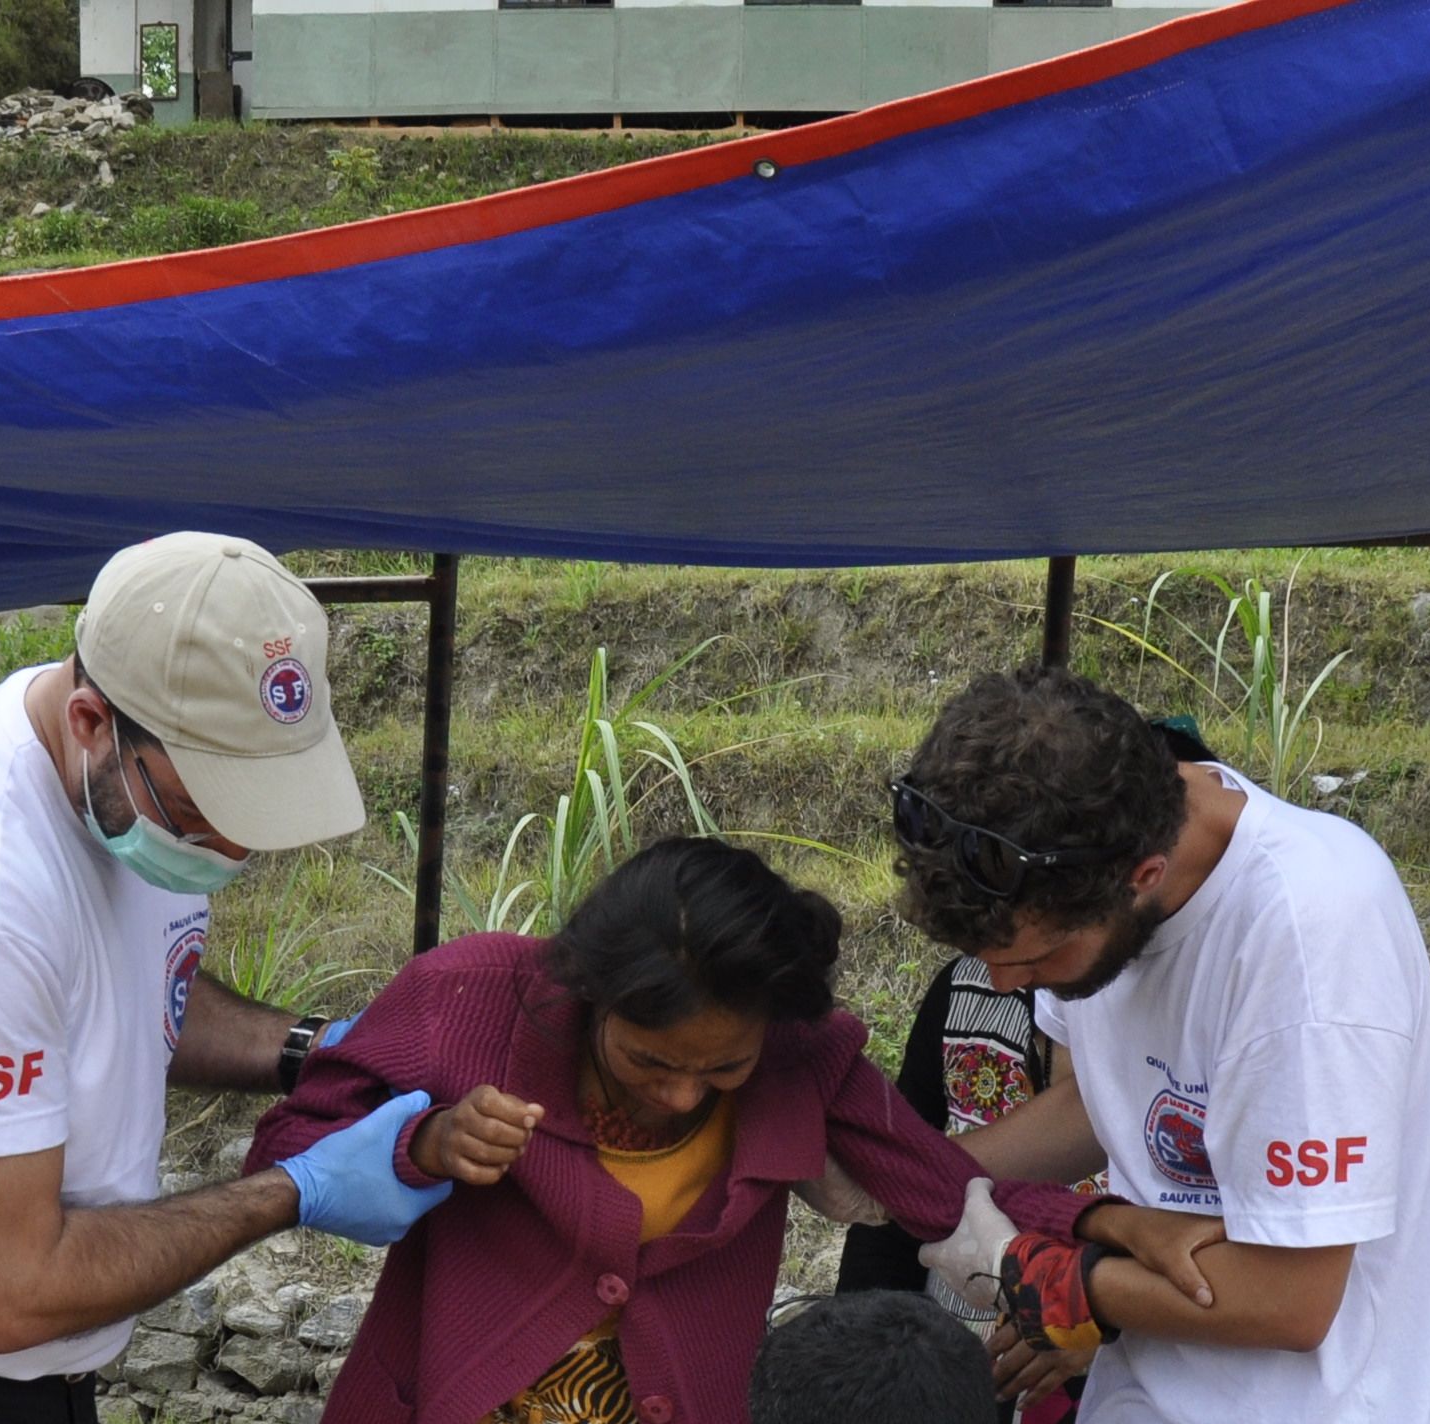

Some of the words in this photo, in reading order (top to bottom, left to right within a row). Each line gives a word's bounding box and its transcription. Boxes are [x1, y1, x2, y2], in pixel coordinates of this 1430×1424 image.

[263, 637, 292, 659] SSF
[1146, 1055, 1166, 1072] QUI
[1266, 1136, 1368, 1187] SSF
[1159, 1191, 1202, 1205] SAUVE
